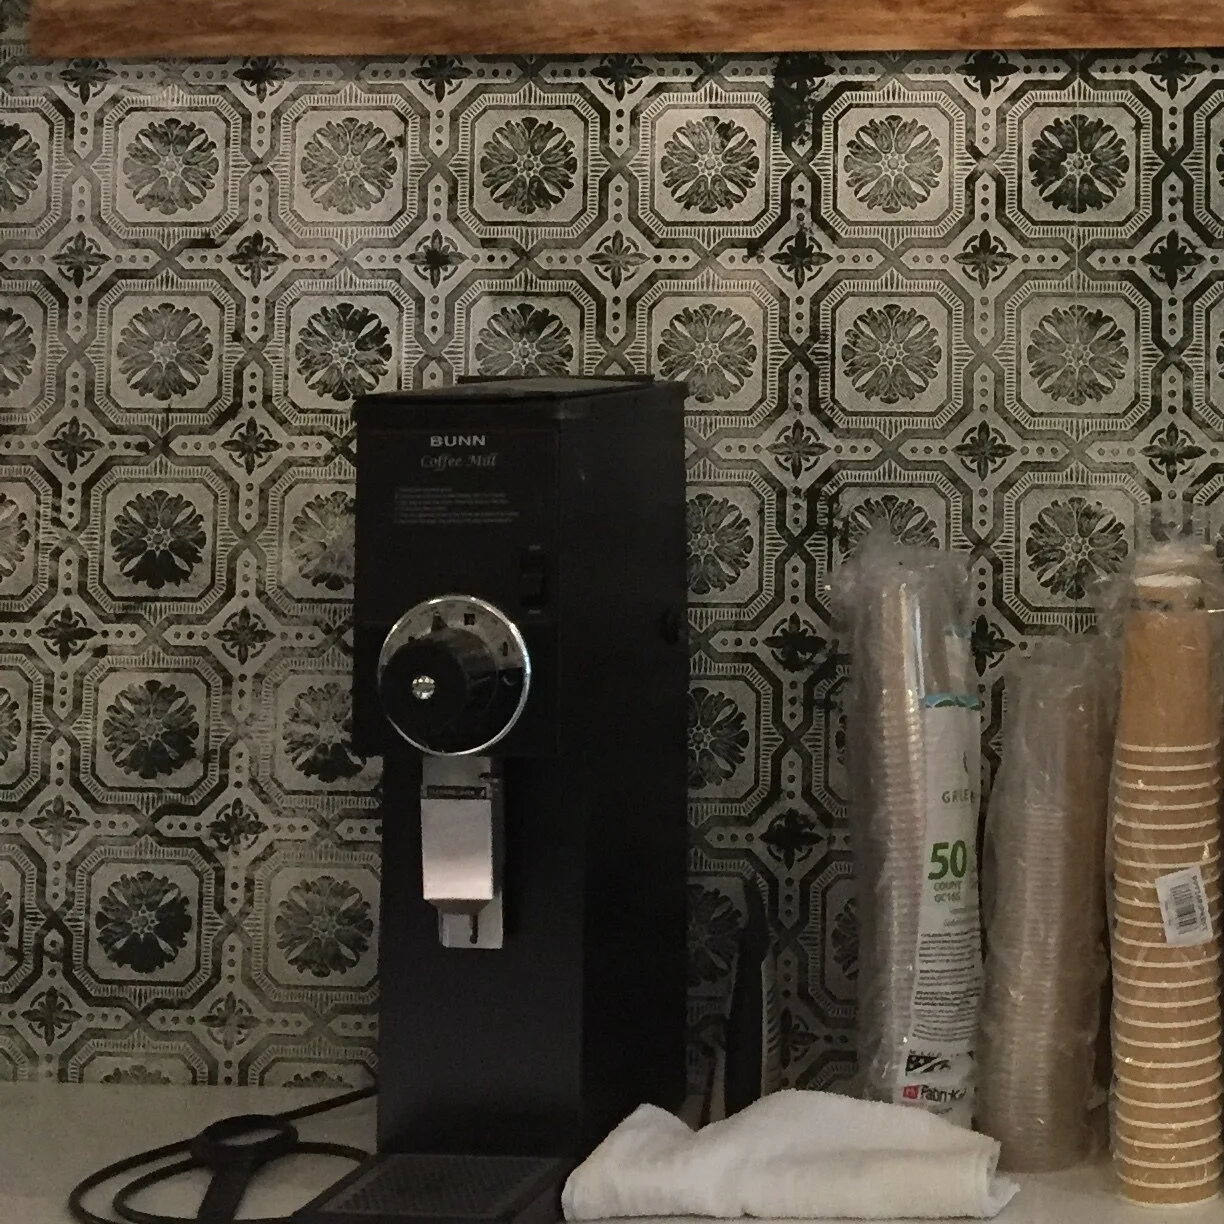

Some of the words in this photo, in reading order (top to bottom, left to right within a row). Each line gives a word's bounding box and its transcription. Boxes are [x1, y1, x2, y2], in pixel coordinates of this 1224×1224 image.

[430, 435, 486, 447] BUNN
[421, 454, 462, 472] Coffee
[928, 840, 967, 880] 50
